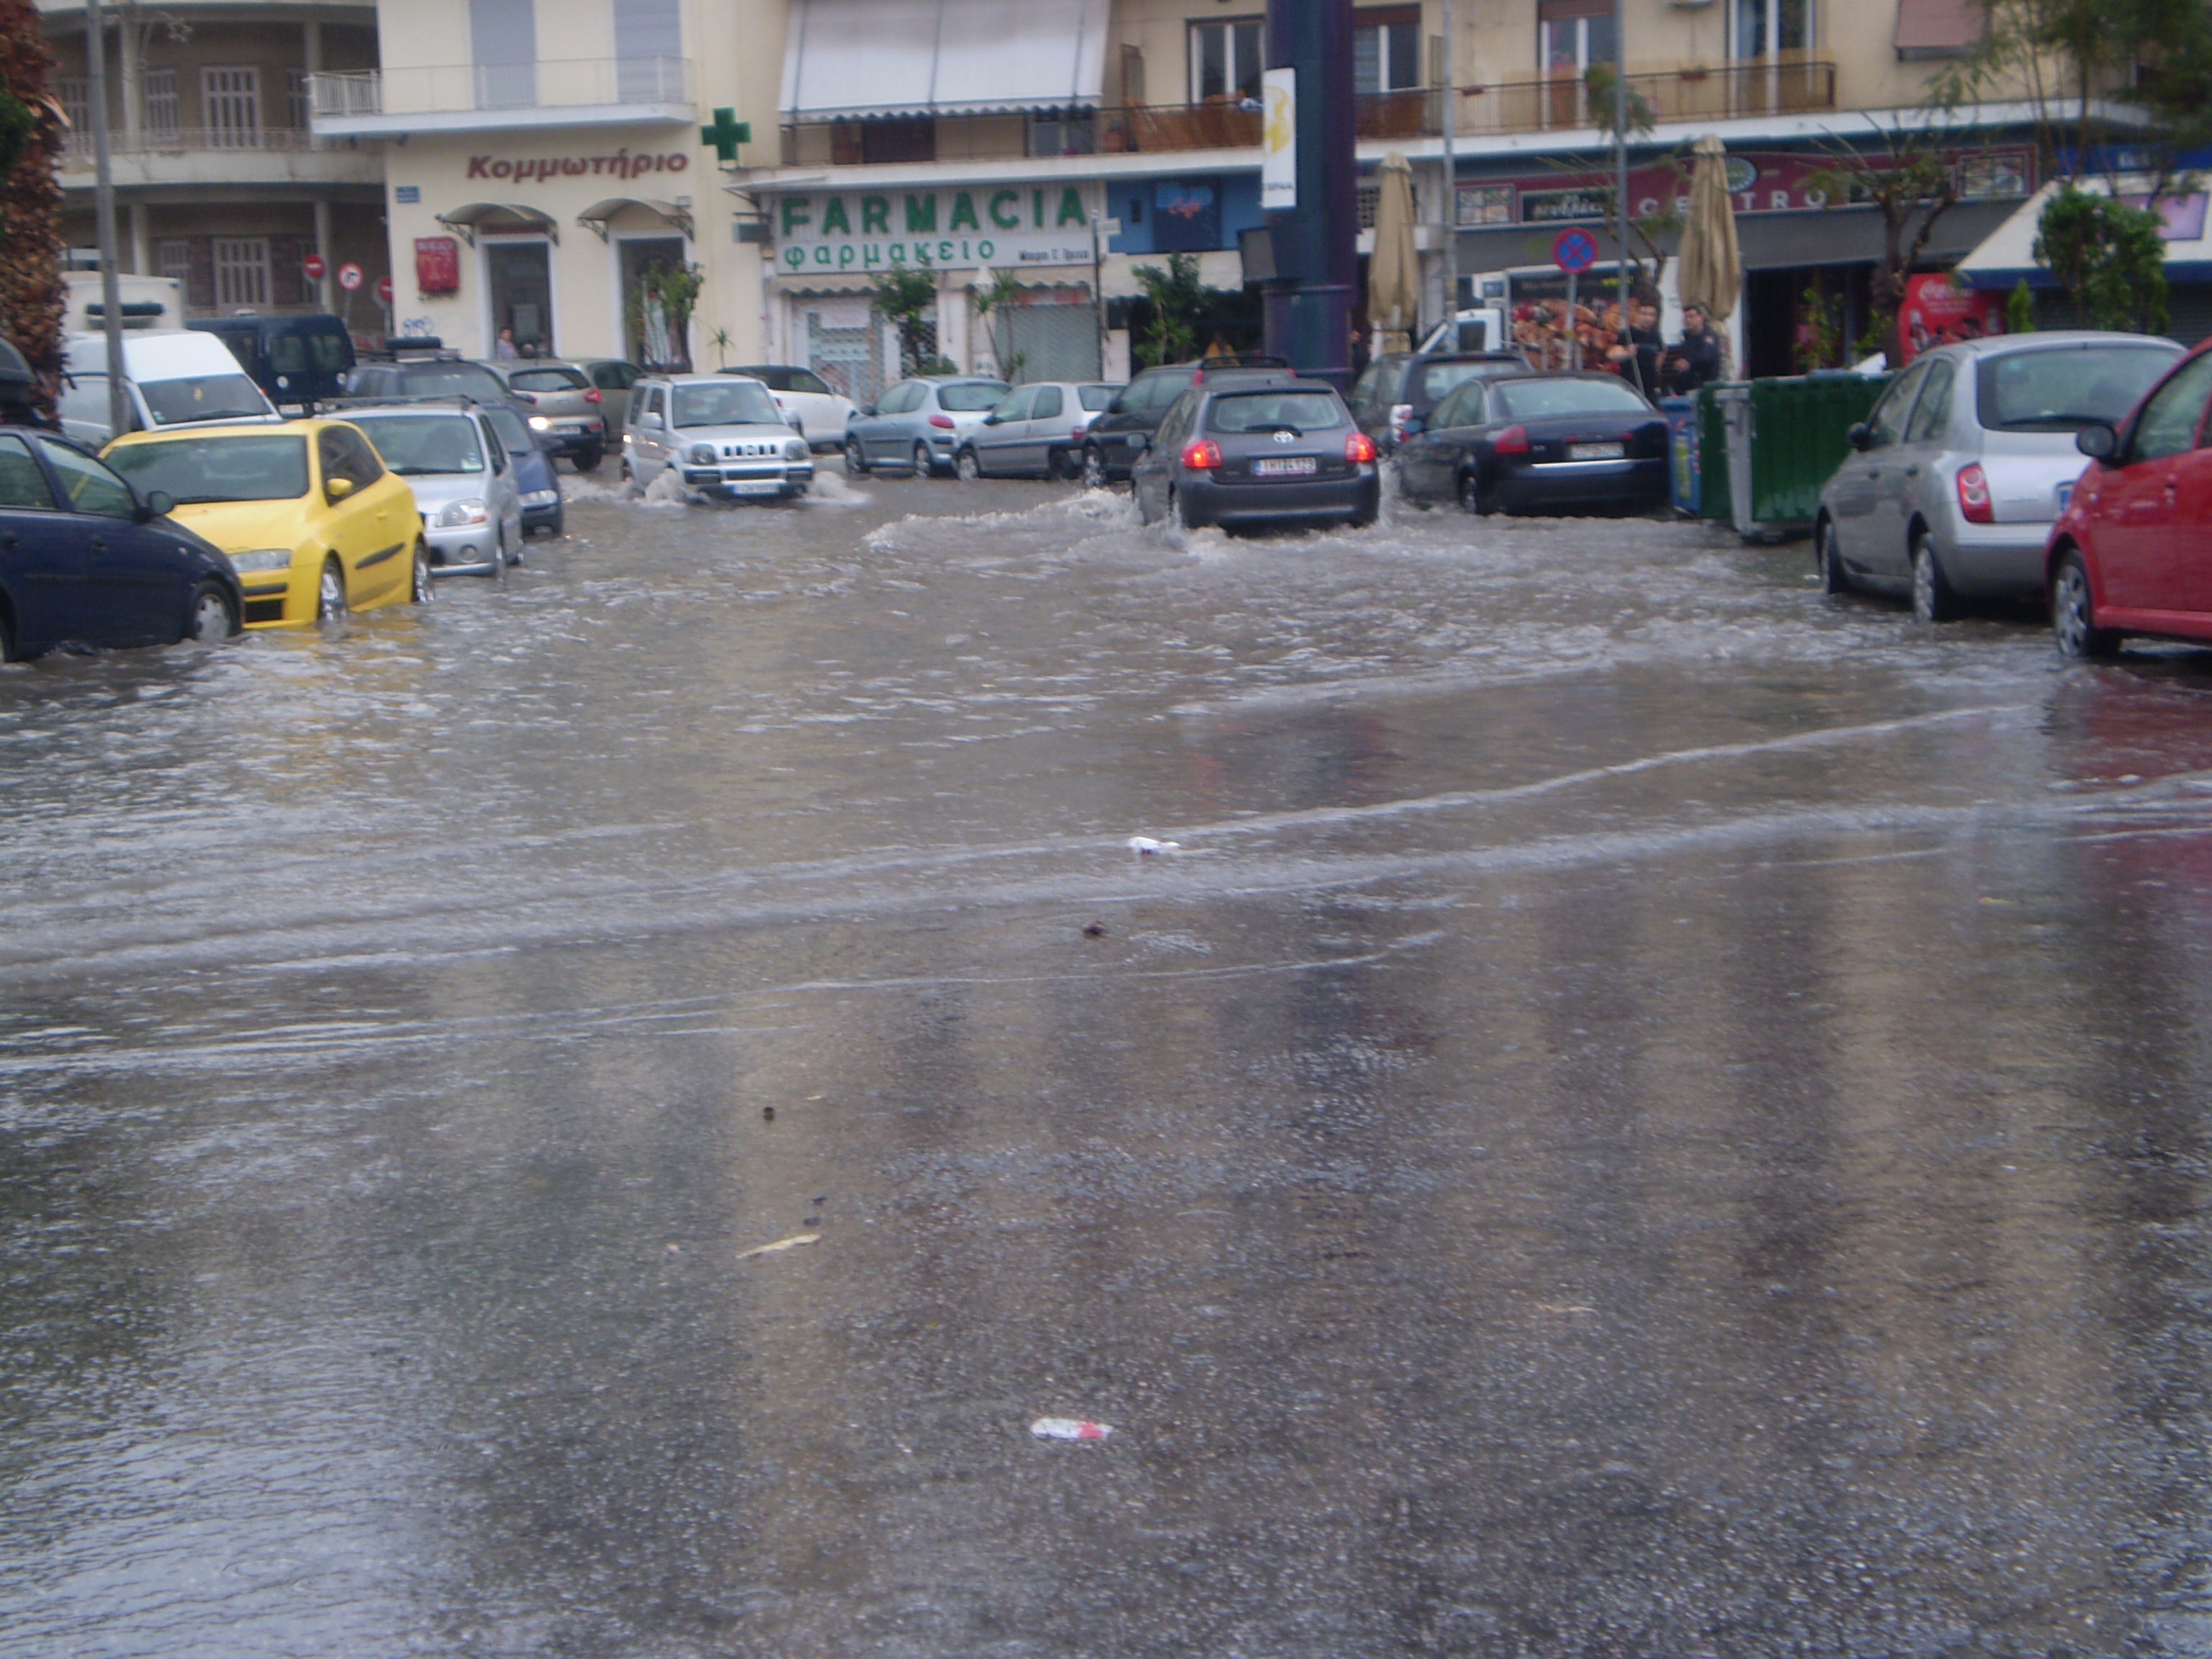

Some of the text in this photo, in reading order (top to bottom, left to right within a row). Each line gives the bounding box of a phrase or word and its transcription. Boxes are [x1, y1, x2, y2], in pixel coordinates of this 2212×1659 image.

[467, 148, 689, 183] Κομμωτήριο
[782, 186, 1087, 235] FARMACIA
[1638, 189, 1827, 216] CETRO
[784, 239, 995, 270] φαρμακειο
